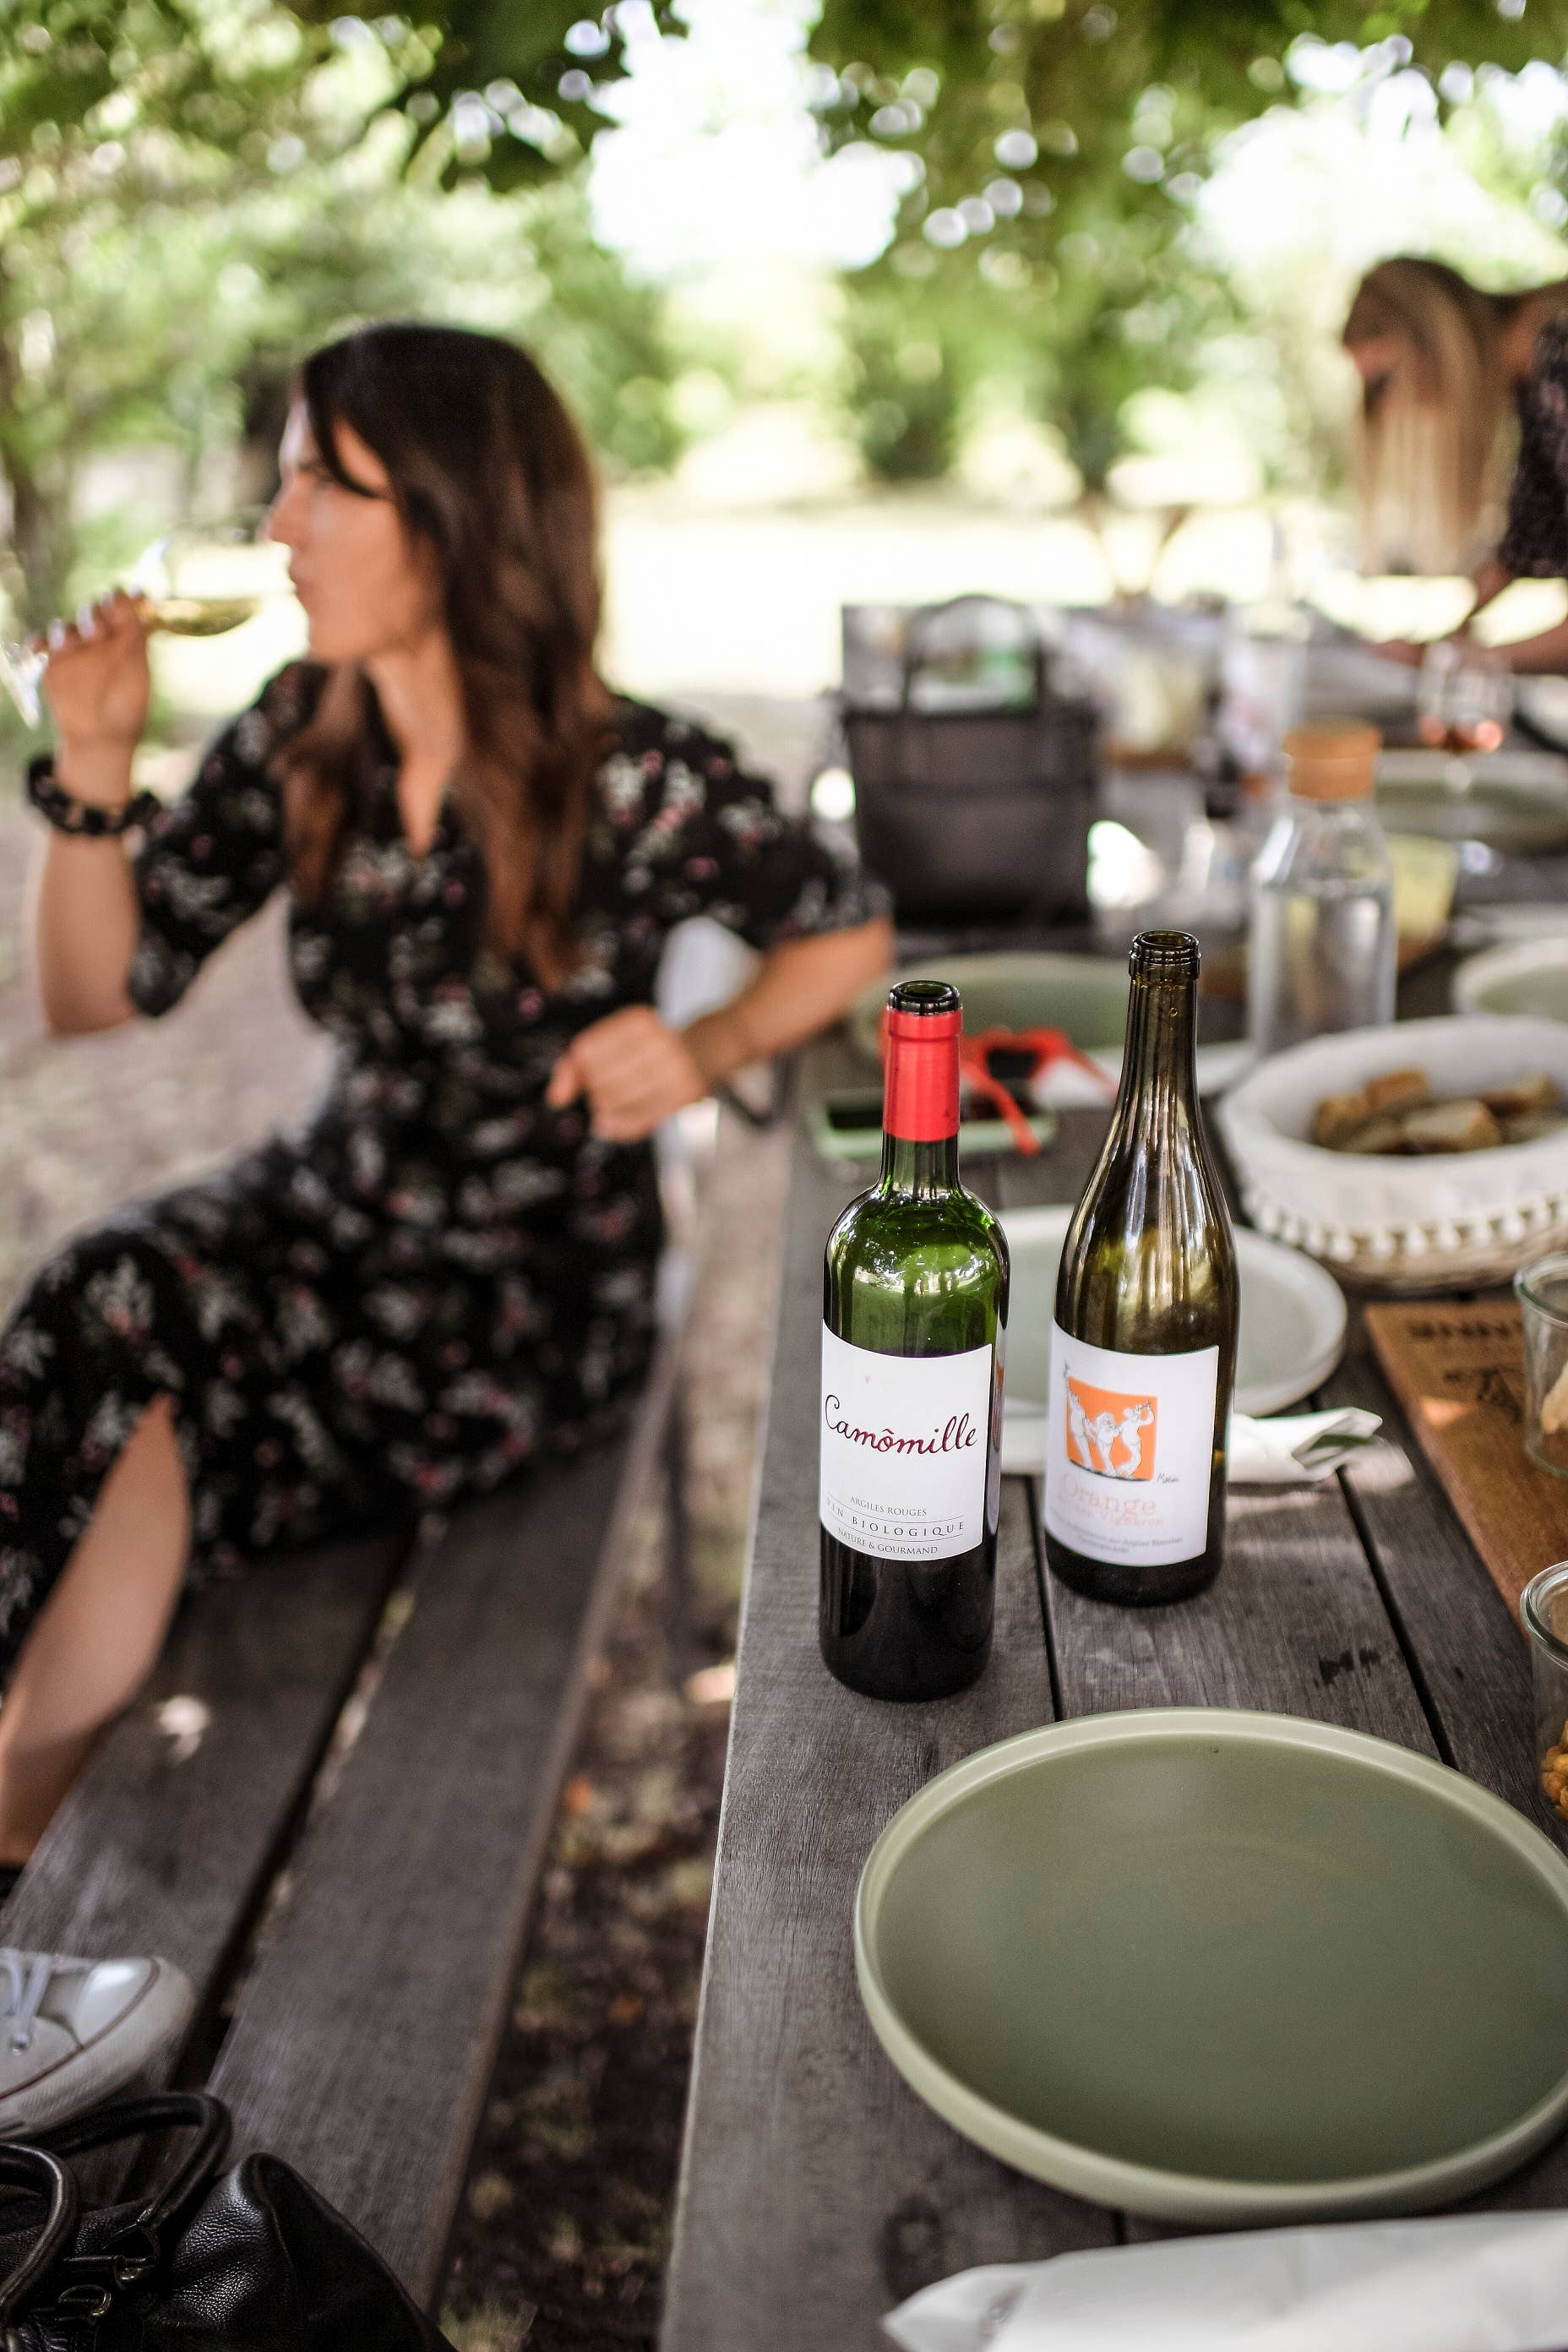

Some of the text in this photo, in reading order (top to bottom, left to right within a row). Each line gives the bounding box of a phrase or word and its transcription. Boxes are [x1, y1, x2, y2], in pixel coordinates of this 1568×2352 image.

[825, 1394, 977, 1454] Camômille
[850, 1496, 927, 1516] ARGILES ROUGES
[1063, 1473, 1156, 1515] Orange
[826, 1498, 965, 1536] VIN BIOLOGIQUE
[838, 1527, 867, 1546] NATURE
[878, 1544, 938, 1554] GOURMAND
